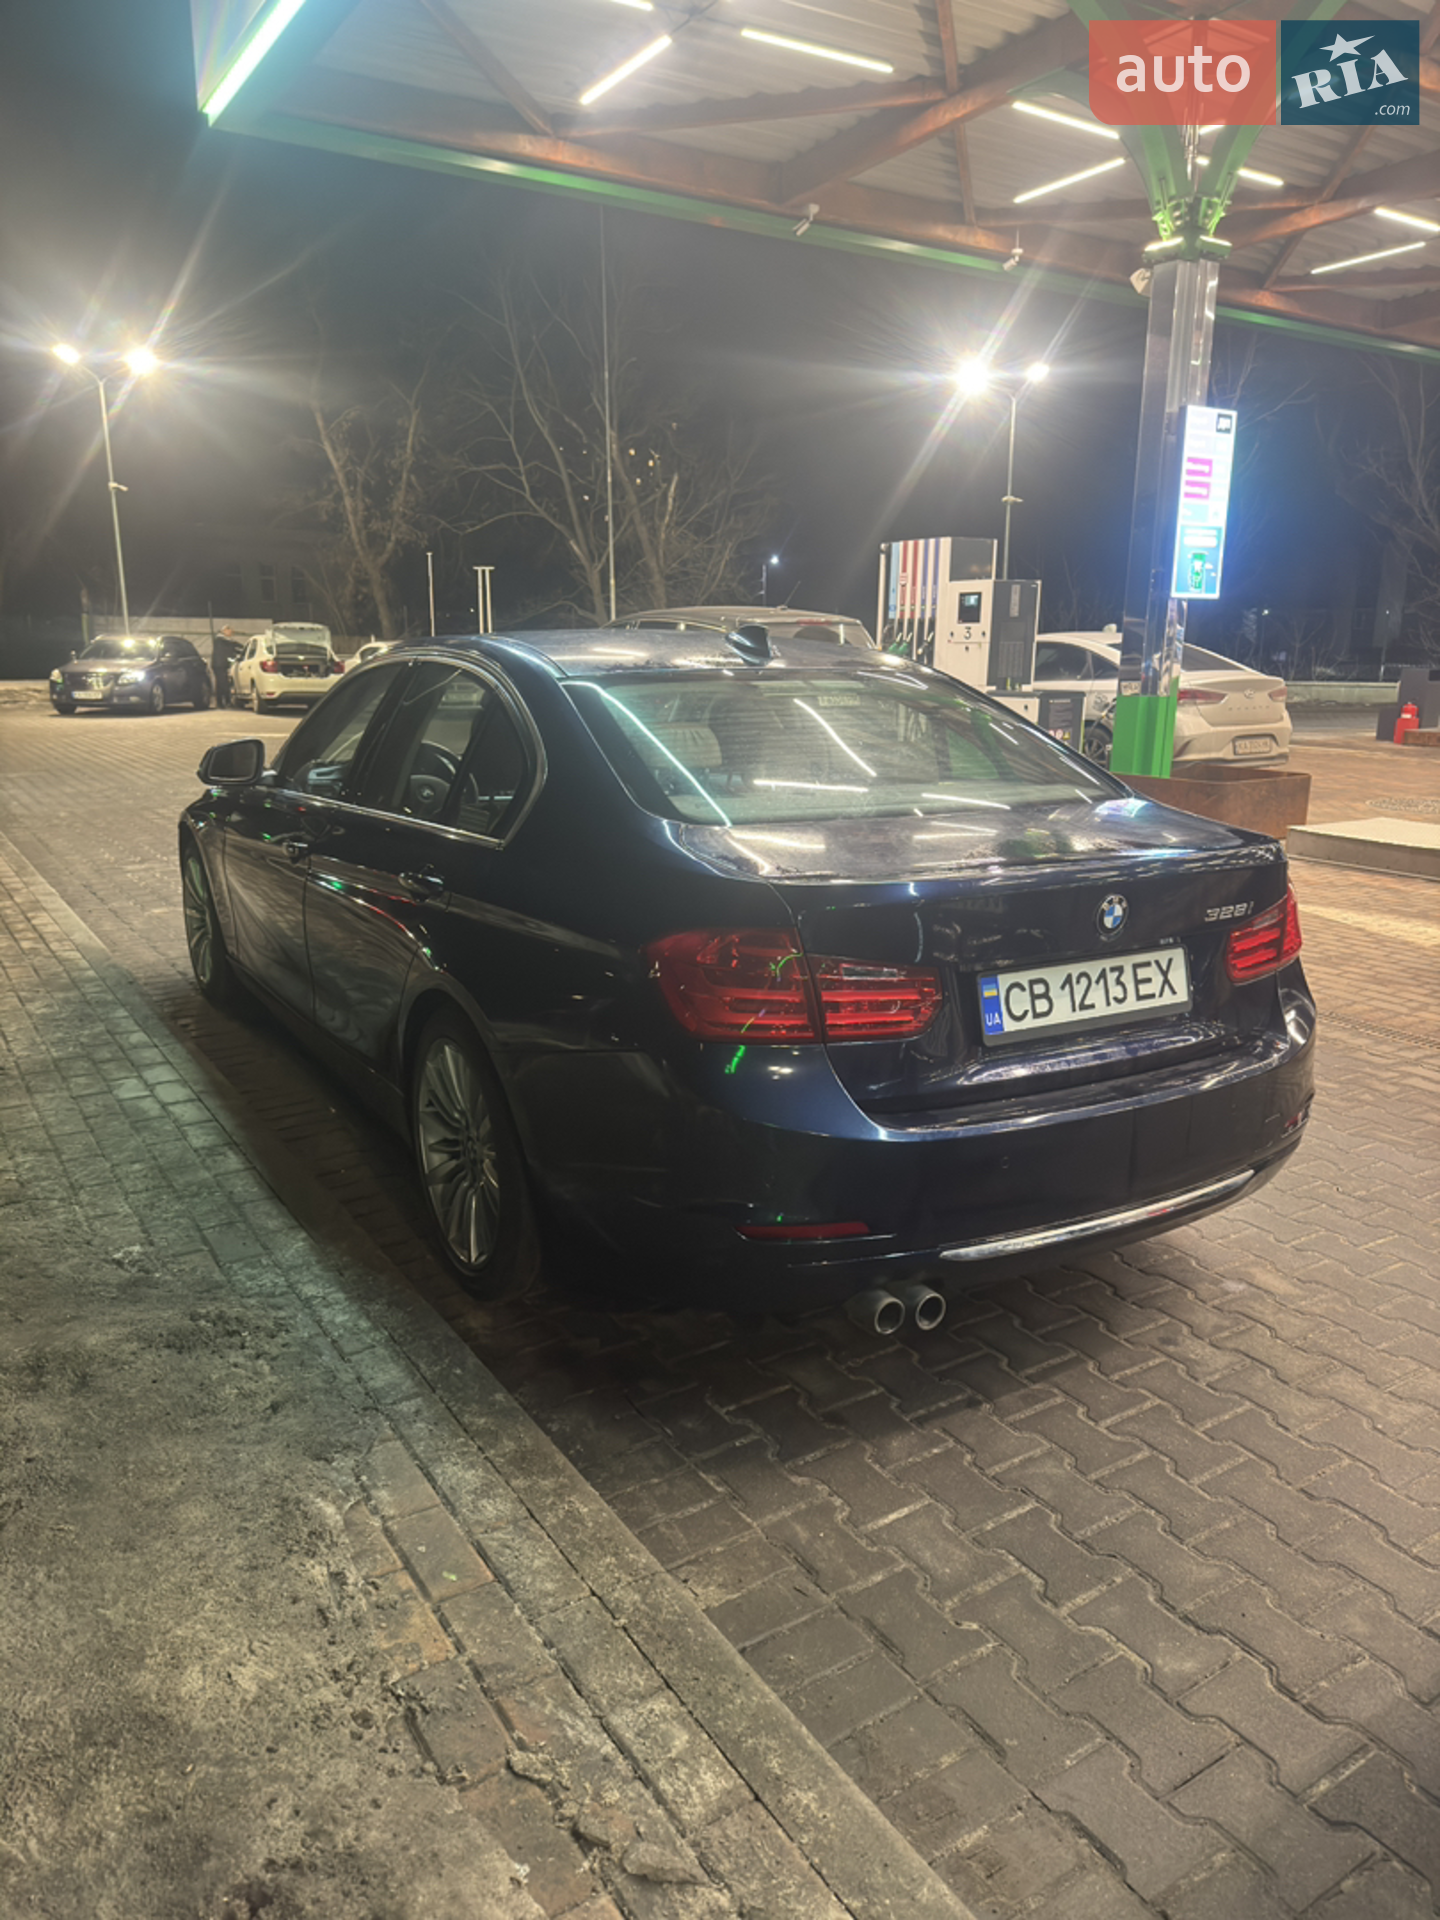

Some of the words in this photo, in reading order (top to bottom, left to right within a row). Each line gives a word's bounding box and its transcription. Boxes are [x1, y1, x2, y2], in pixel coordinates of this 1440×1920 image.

[963, 626, 972, 640] 3
[1004, 977, 1055, 1022] CB
[1060, 965, 1128, 1013] 1213
[1132, 957, 1178, 1002] EX
[985, 1012, 1002, 1027] UA
